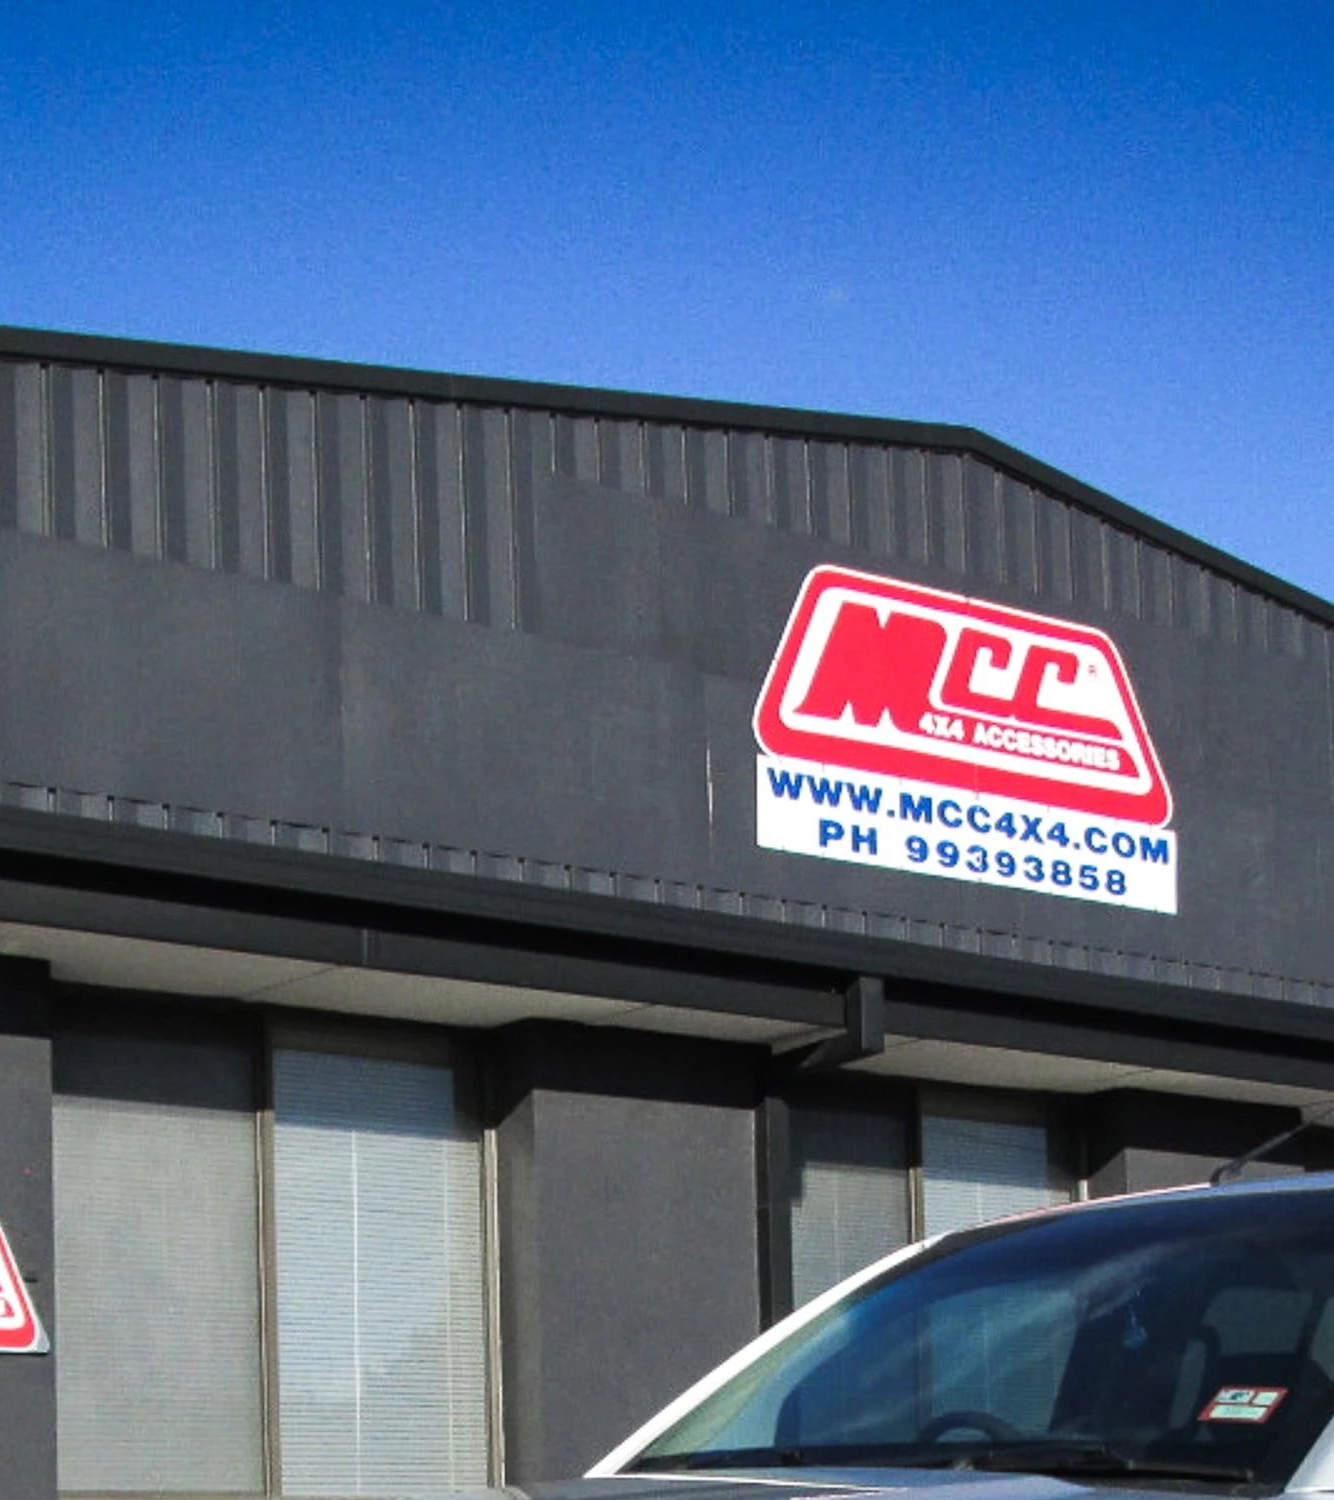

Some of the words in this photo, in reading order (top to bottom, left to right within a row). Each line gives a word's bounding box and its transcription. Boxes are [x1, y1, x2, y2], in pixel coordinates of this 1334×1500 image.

[792, 600, 1124, 732] MCC
[918, 711, 965, 742] 4X4
[972, 715, 1121, 771] ACCESSORIES
[767, 767, 1170, 864] WWW.MCC4X4.COM
[818, 819, 878, 856] PH
[905, 835, 1128, 895] 99393858
